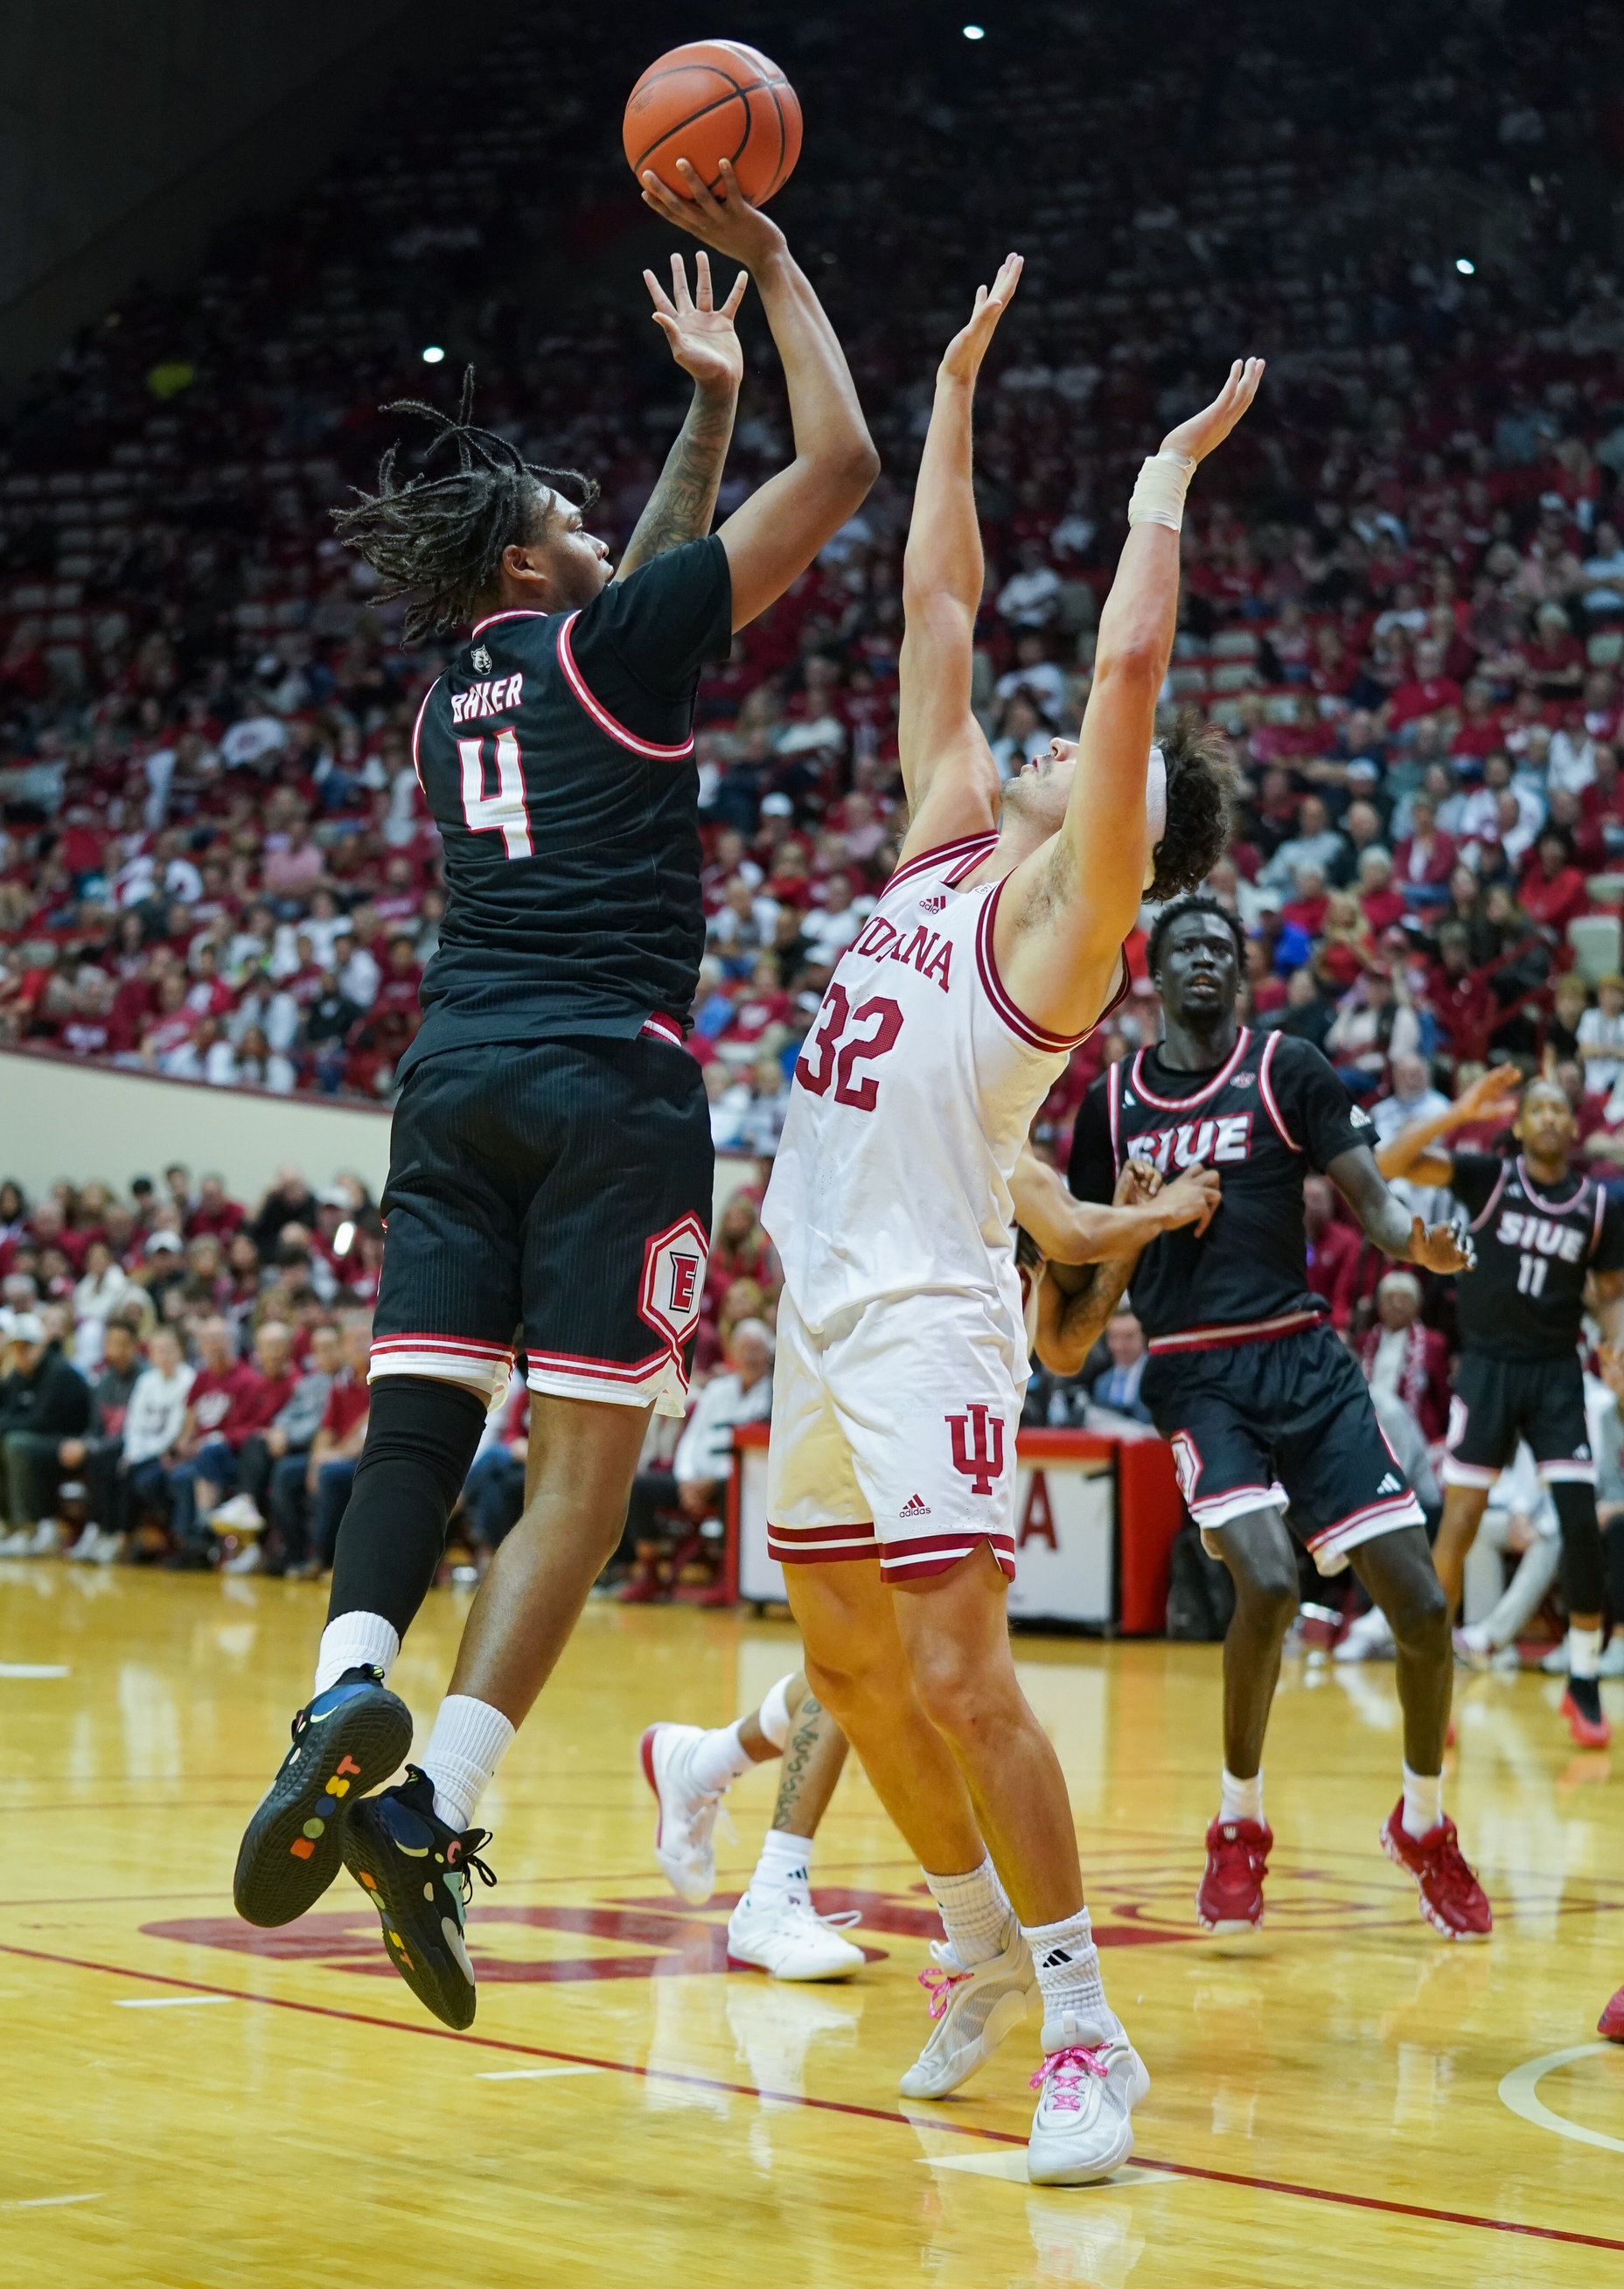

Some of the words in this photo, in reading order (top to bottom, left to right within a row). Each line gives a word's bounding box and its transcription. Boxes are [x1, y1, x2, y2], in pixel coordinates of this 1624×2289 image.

[450, 672, 524, 725] BAKER
[457, 726, 534, 860] 4
[918, 899, 940, 916] adid
[795, 982, 904, 1112] 32
[1496, 1211, 1586, 1263] SIUE
[669, 1252, 699, 1313] E
[1516, 1253, 1548, 1298] 11
[899, 1506, 931, 1518] adidas
